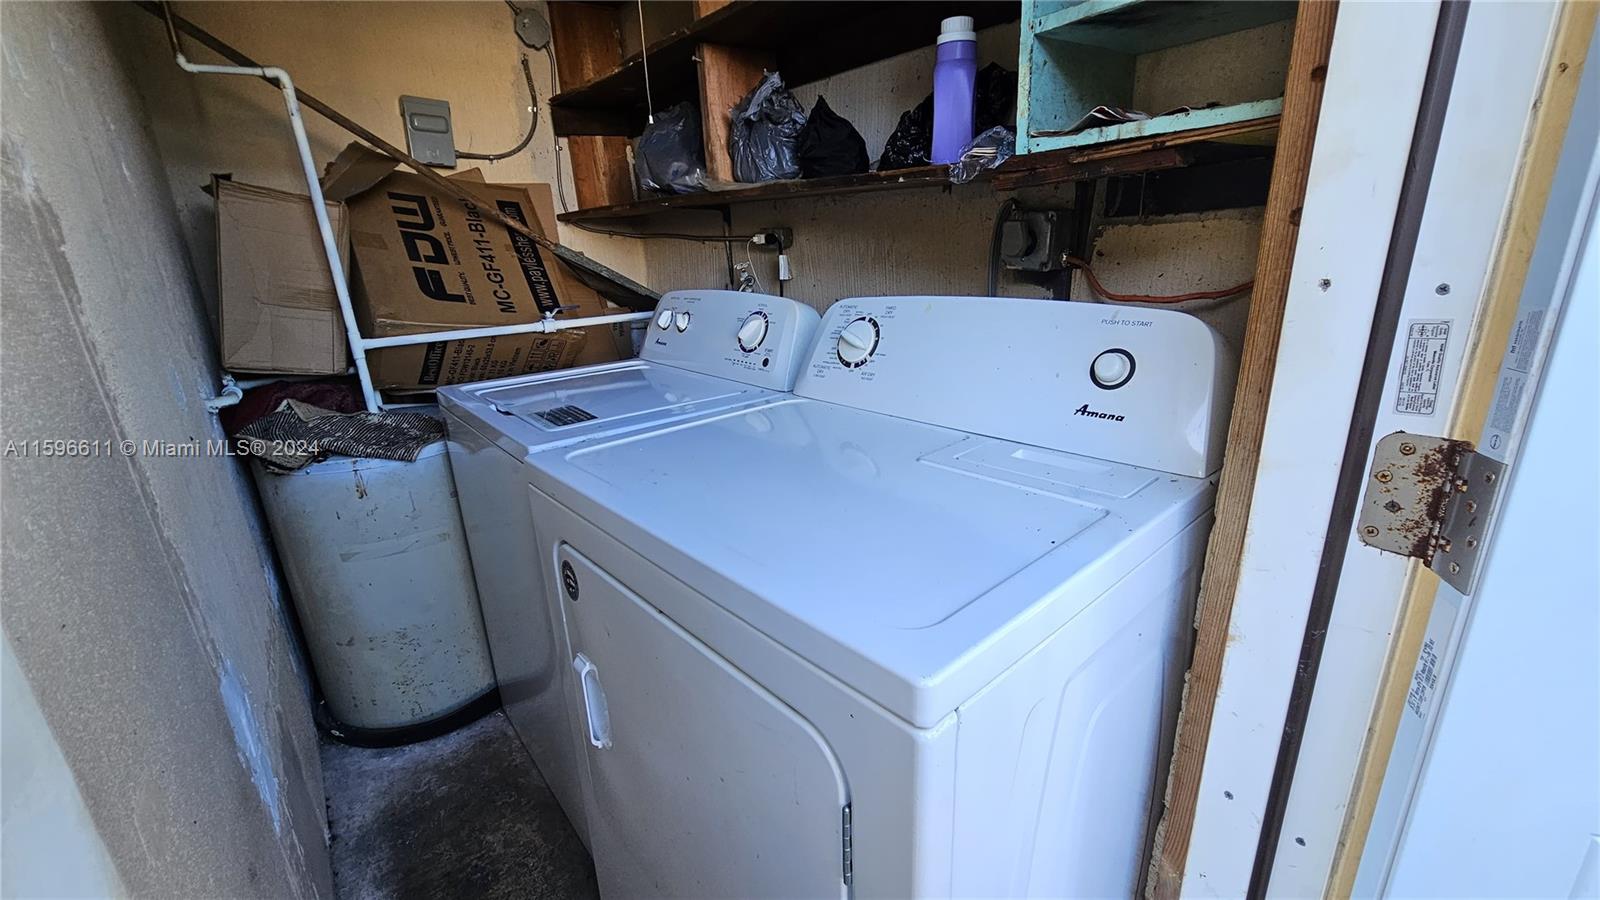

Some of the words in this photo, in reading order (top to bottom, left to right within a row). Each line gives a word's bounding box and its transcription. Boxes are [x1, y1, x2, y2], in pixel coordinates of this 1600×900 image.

[386, 191, 467, 303] FDW
[505, 206, 553, 307] www.paylessheom
[1074, 403, 1125, 421] Amana
